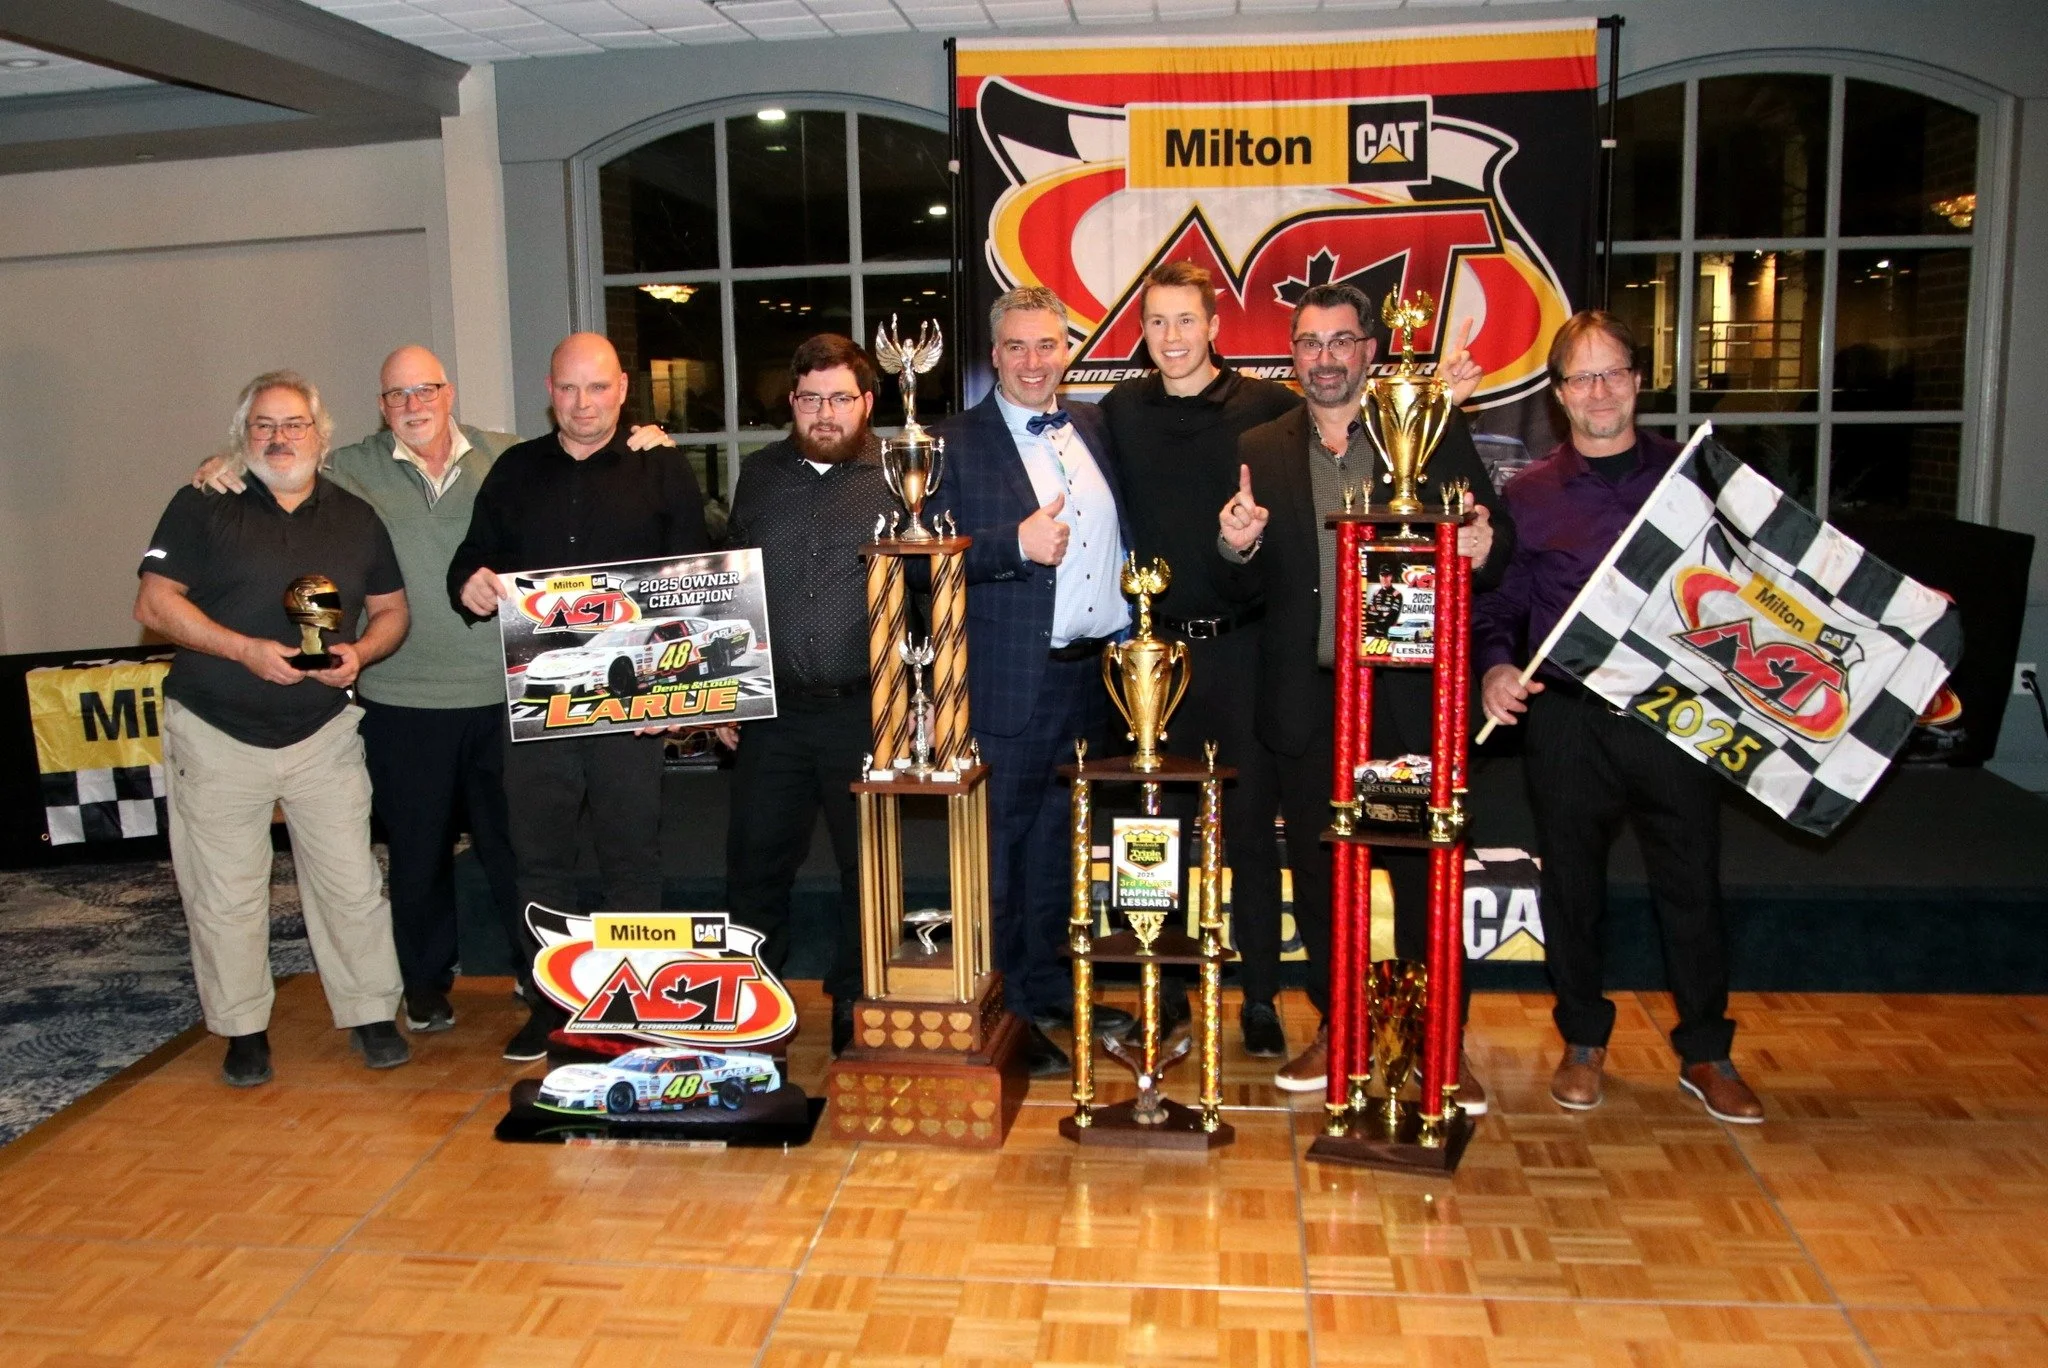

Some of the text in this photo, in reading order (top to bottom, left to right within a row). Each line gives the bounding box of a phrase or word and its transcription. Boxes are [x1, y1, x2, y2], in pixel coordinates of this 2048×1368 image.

[1165, 121, 1419, 169] Milton CAT
[1063, 368, 1160, 382] AMERI
[1366, 362, 1438, 376] TOR
[553, 576, 606, 590] Milton CAT
[639, 571, 740, 593] 2025 OWNER
[649, 589, 733, 609] CHAMPION
[1412, 593, 1433, 604] 2025
[543, 593, 625, 628] ACT
[1754, 586, 1852, 656] Milton CAT
[658, 639, 693, 672] 48
[1366, 638, 1390, 655] 48
[1396, 647, 1435, 655] LESSAR
[1682, 620, 1843, 711] ACT
[652, 678, 739, 694] Denis & Louis
[545, 687, 740, 728] LARUE
[1635, 685, 1763, 774] 2025
[1362, 784, 1380, 792] 2025
[1120, 889, 1171, 898] RAPHAEL
[1139, 880, 1173, 888] PLACE
[1121, 898, 1171, 907] LESSARD
[611, 923, 724, 943] Milton CAT
[1463, 886, 1546, 960] CA
[578, 957, 762, 1023] ACT
[570, 1023, 737, 1032] AMERICAN CANADIAN TOUR
[662, 1074, 703, 1100] 48
